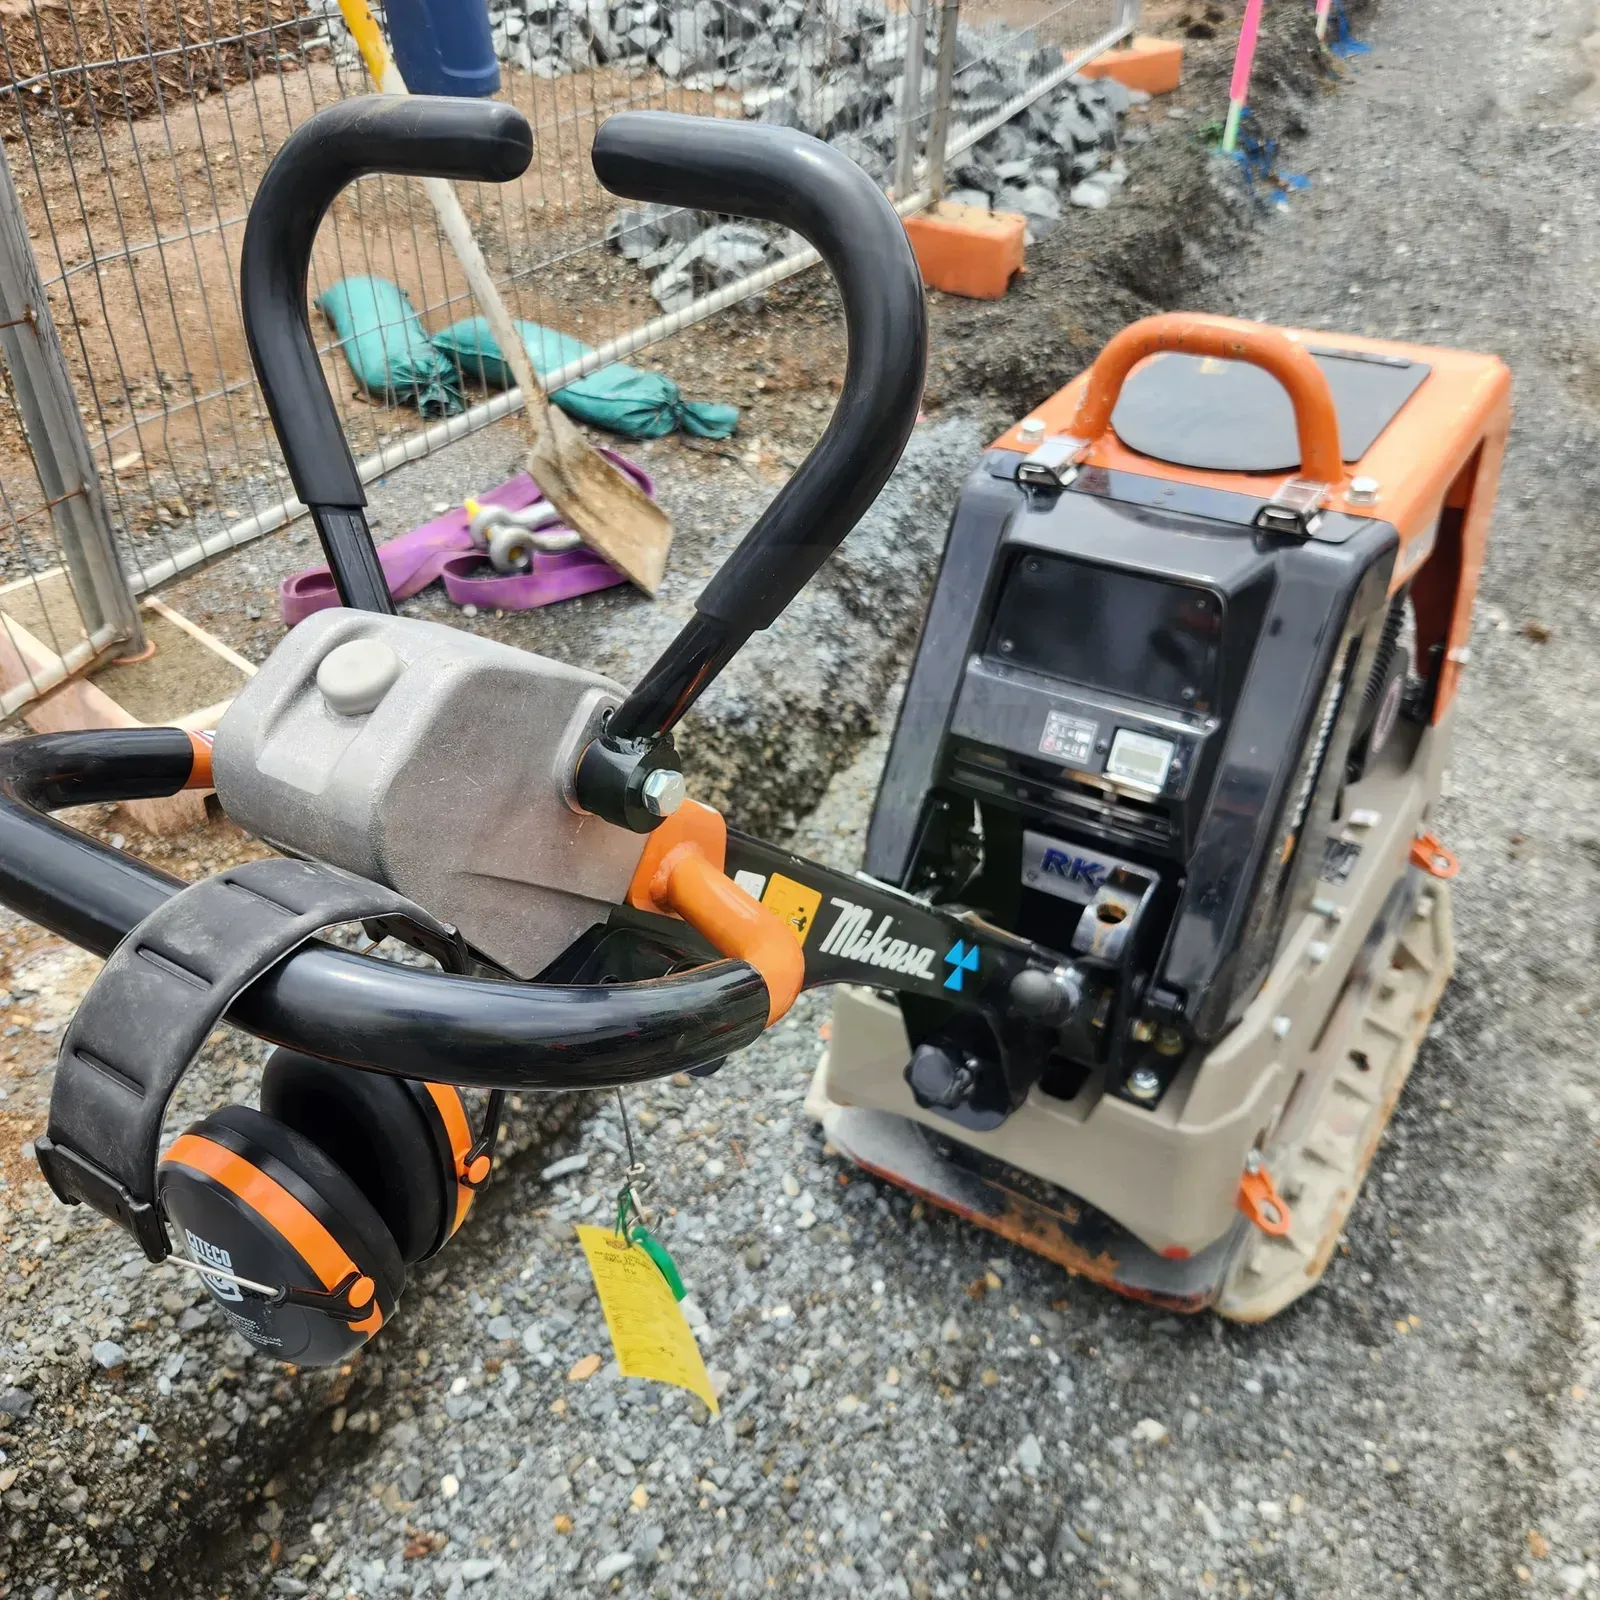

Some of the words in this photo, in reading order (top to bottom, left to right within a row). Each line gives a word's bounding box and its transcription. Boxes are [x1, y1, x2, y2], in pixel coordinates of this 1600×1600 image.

[1041, 848, 1105, 887] RK
[818, 896, 936, 980] Mikasa
[185, 1228, 232, 1268] CITECO
